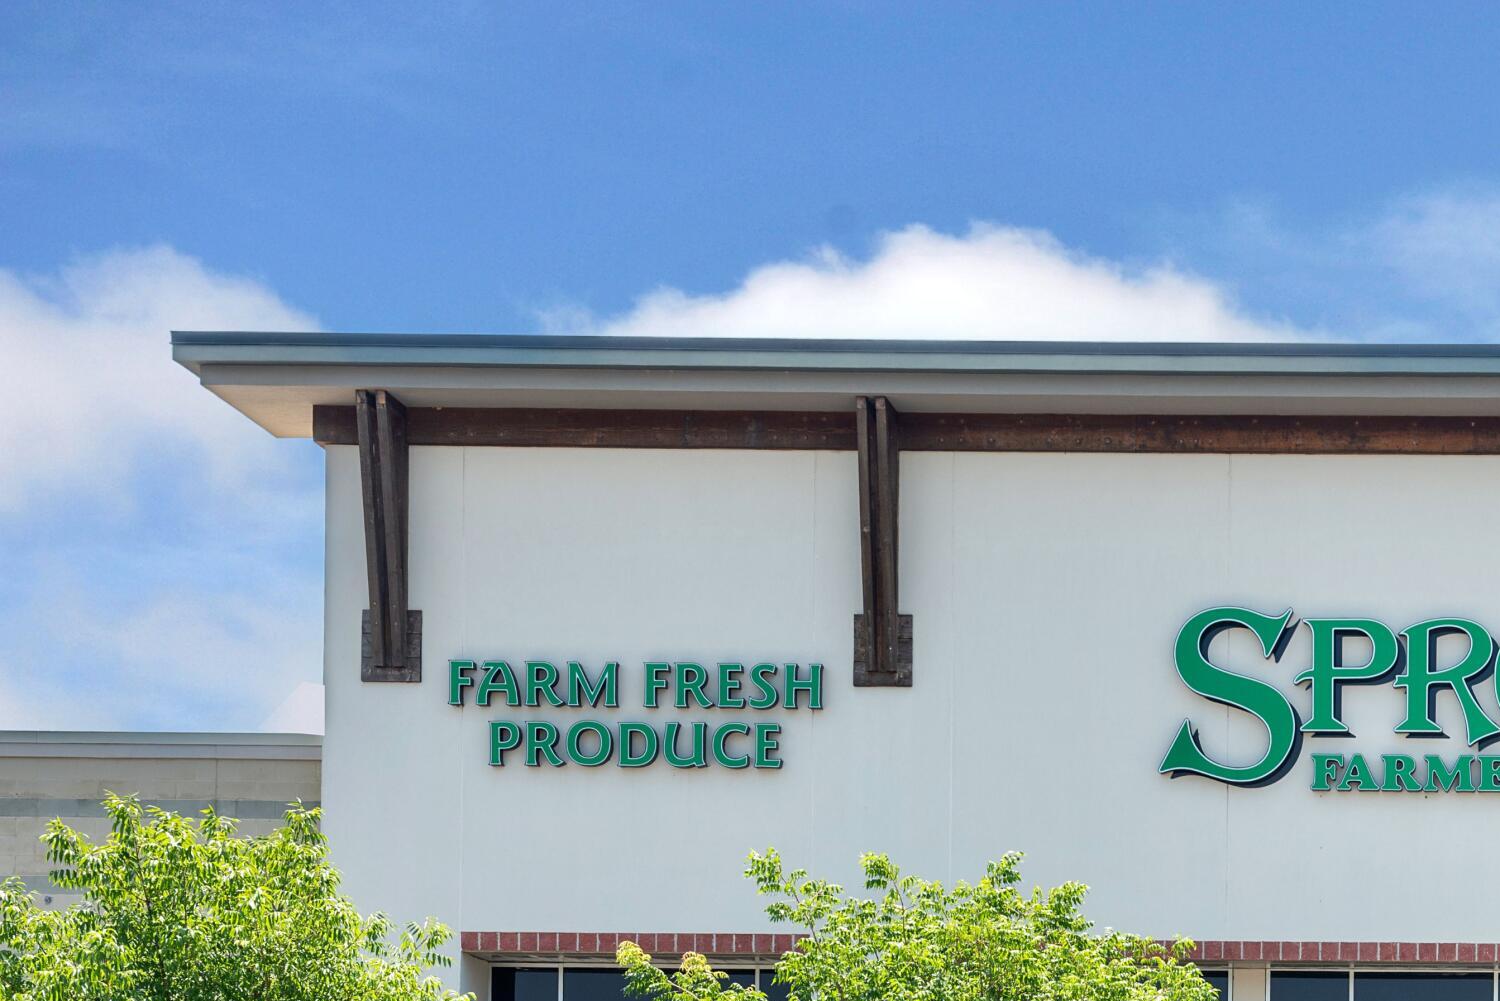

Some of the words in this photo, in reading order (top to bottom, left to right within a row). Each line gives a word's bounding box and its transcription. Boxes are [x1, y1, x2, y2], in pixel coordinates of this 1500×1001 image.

[447, 660, 621, 708] FARM
[642, 661, 824, 709] FRESH
[487, 720, 784, 768] PRODUCE
